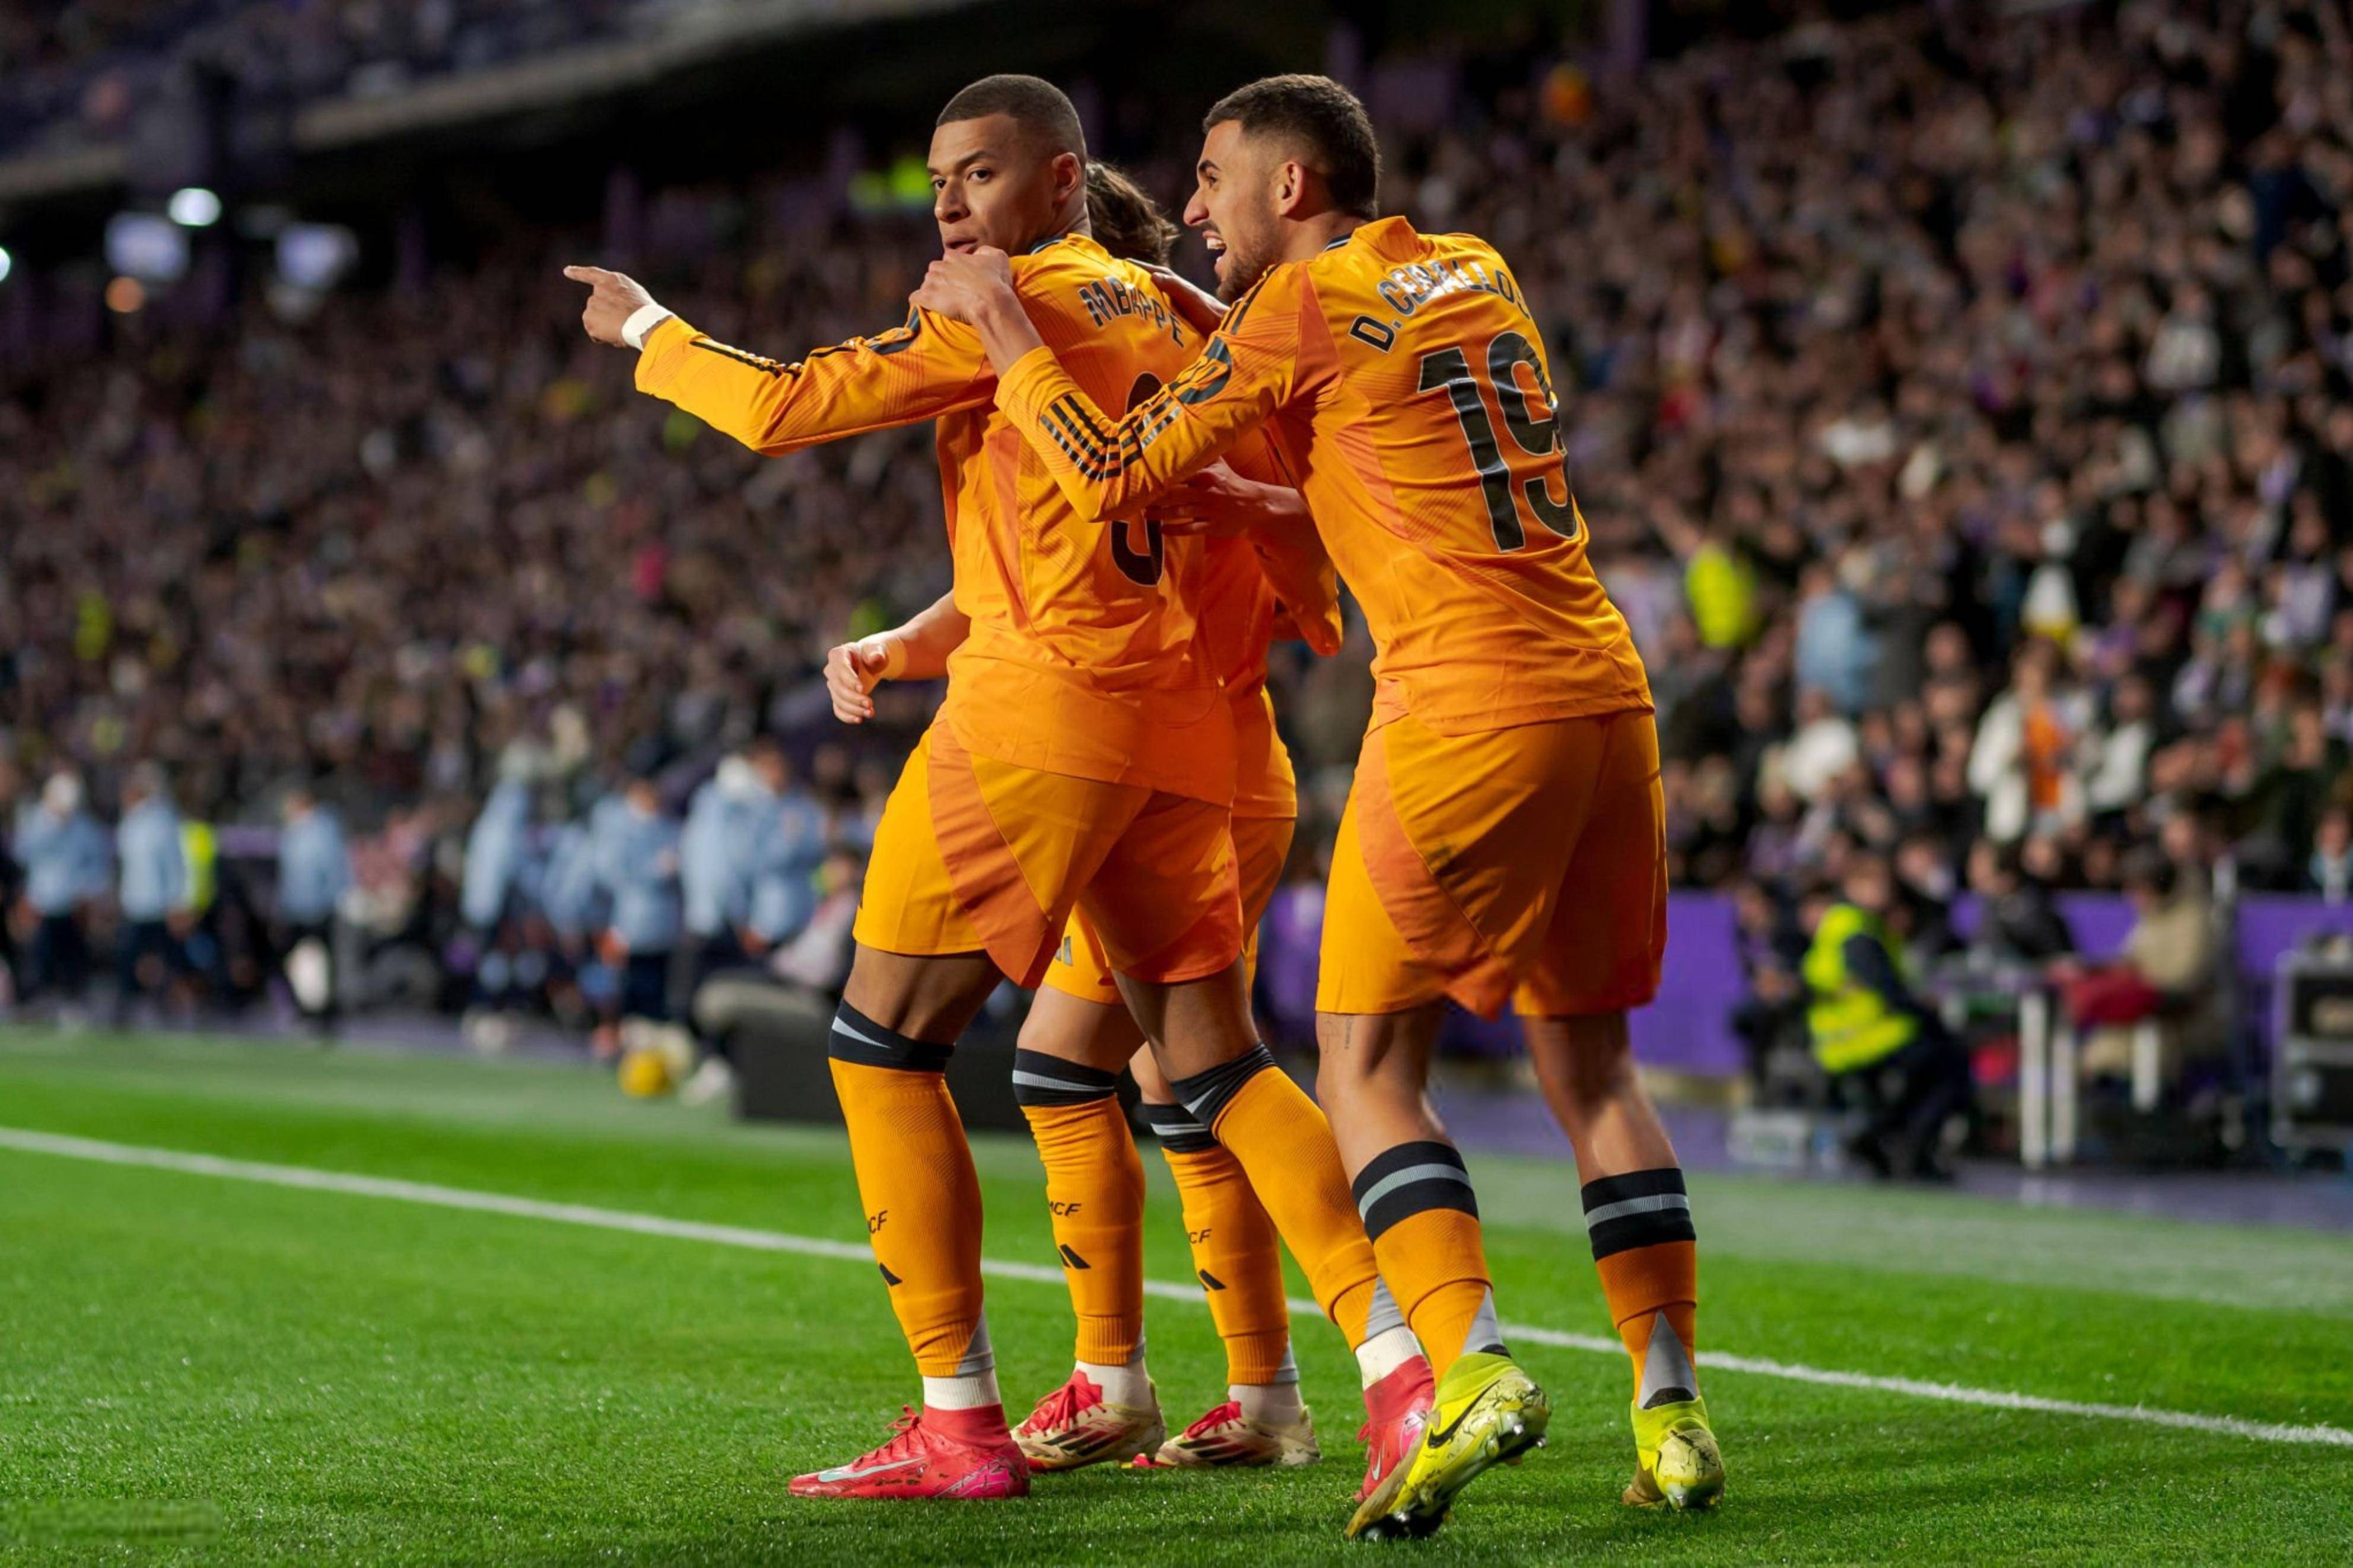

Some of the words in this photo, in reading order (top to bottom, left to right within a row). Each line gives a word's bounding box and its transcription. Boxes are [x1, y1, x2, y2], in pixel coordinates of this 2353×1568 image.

[1348, 313, 1402, 354] D.
[1417, 330, 1579, 553] 19
[867, 1210, 888, 1234] CF
[1188, 1228, 1212, 1244] CF
